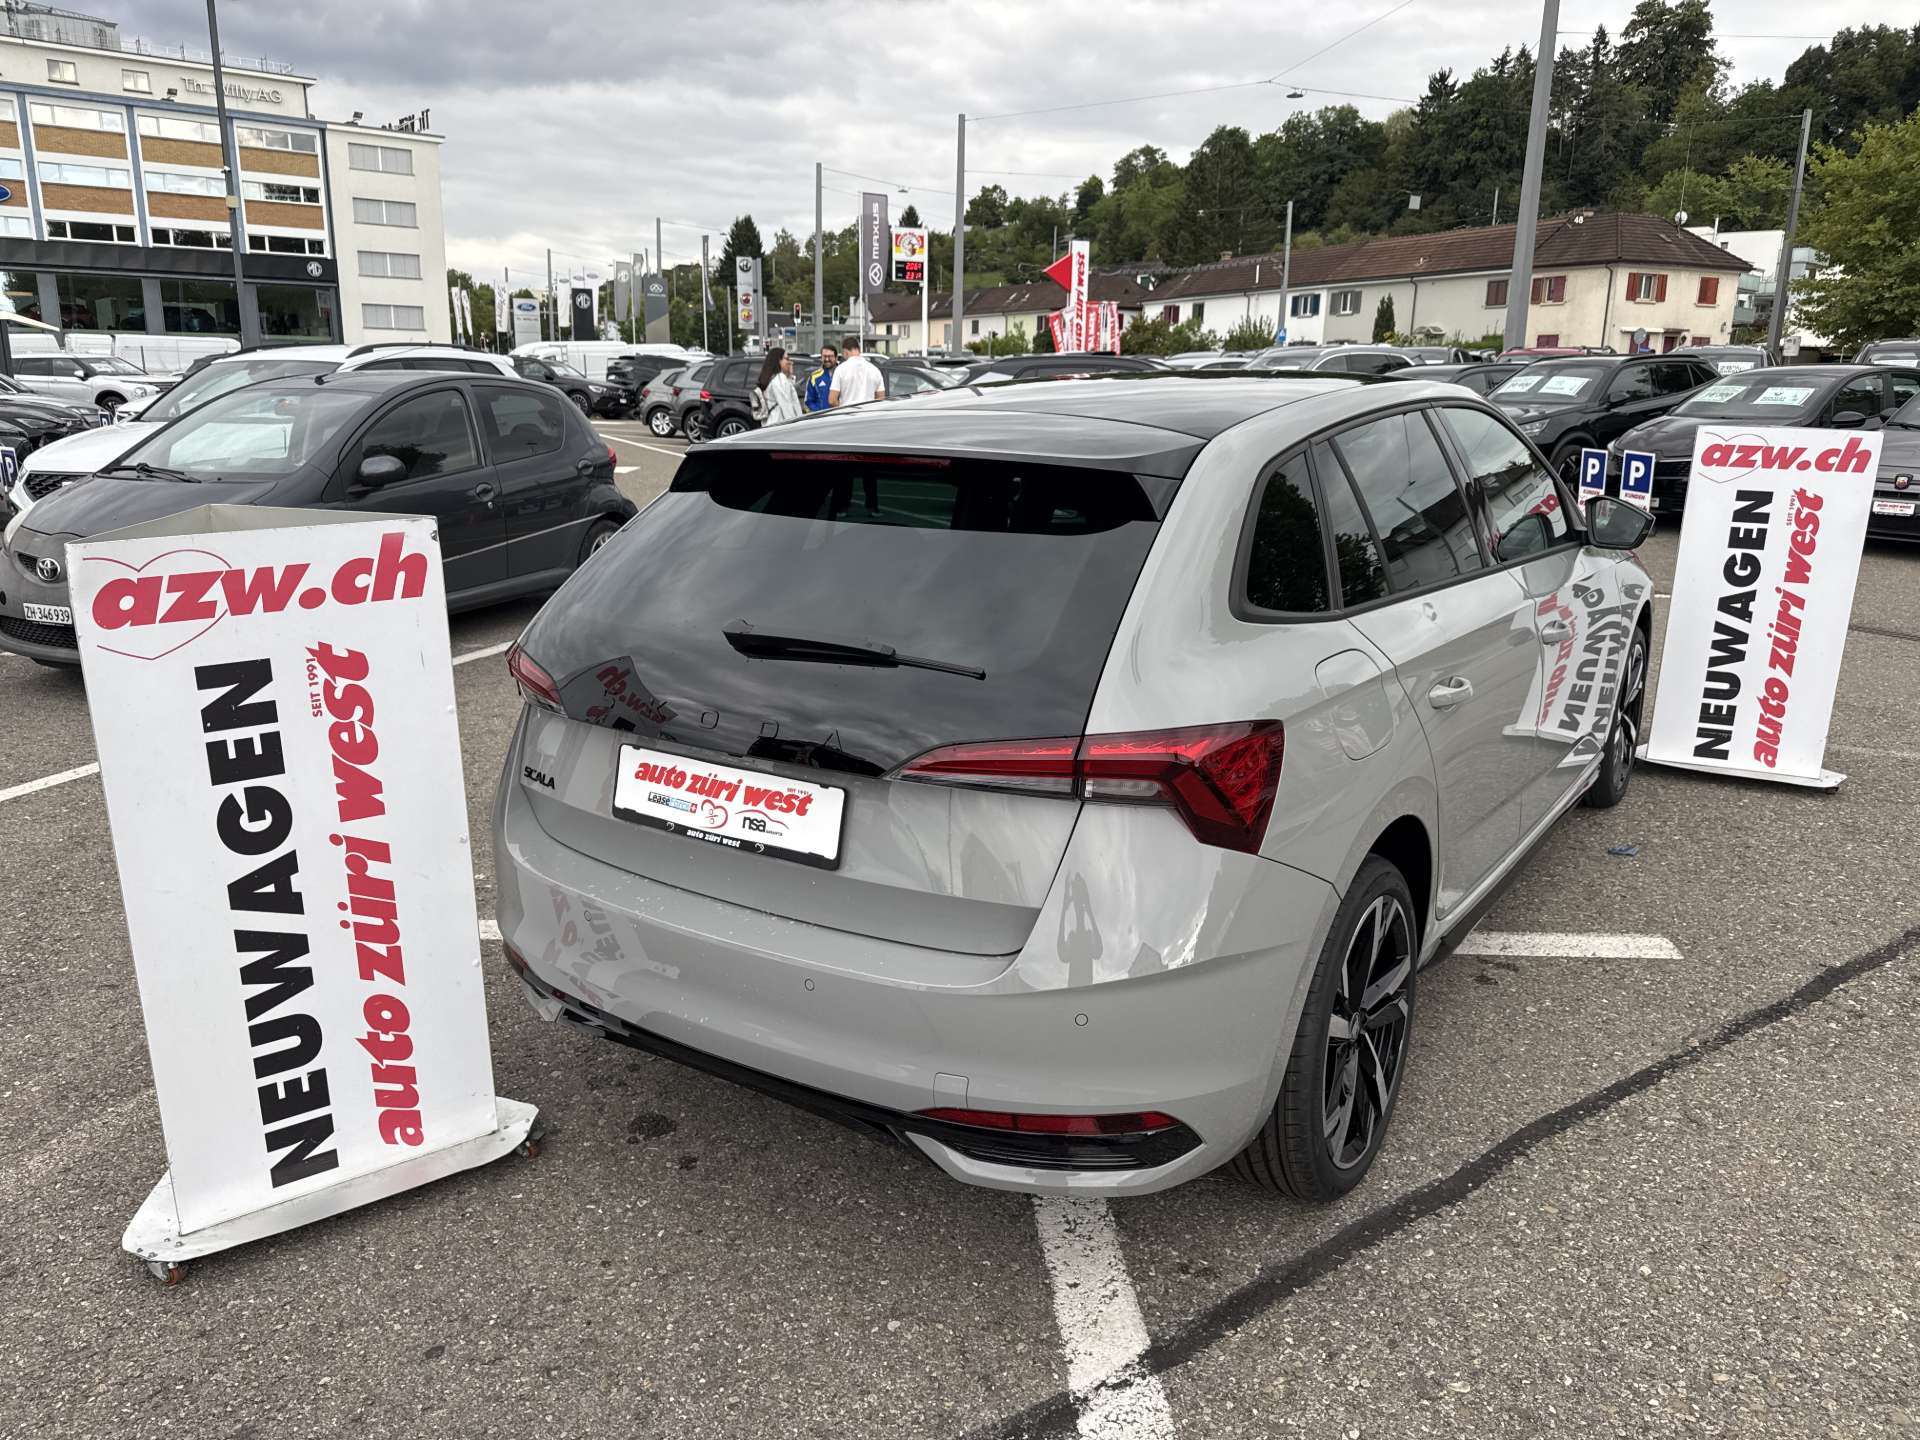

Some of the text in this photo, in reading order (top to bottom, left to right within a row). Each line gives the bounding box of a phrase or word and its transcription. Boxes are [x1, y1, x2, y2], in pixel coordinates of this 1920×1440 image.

[258, 88, 282, 103] AG
[872, 202, 880, 259] MAXUS
[576, 293, 591, 309] MG
[1586, 458, 1600, 483] P
[1629, 460, 1645, 486] P
[1701, 437, 1873, 473] azw.ch
[92, 532, 428, 630] azw.ch
[1693, 489, 1774, 760] NEUWAGEN
[1753, 487, 1824, 769] auto züri west
[306, 657, 323, 718] SEIT 1991
[524, 766, 555, 790] SCALA
[634, 762, 814, 817] auto züri west
[686, 829, 705, 840] auto
[722, 838, 741, 849] west
[742, 816, 767, 833] nsa
[305, 641, 425, 1147] auto züri west
[194, 658, 340, 1189] NEUWAGEN
